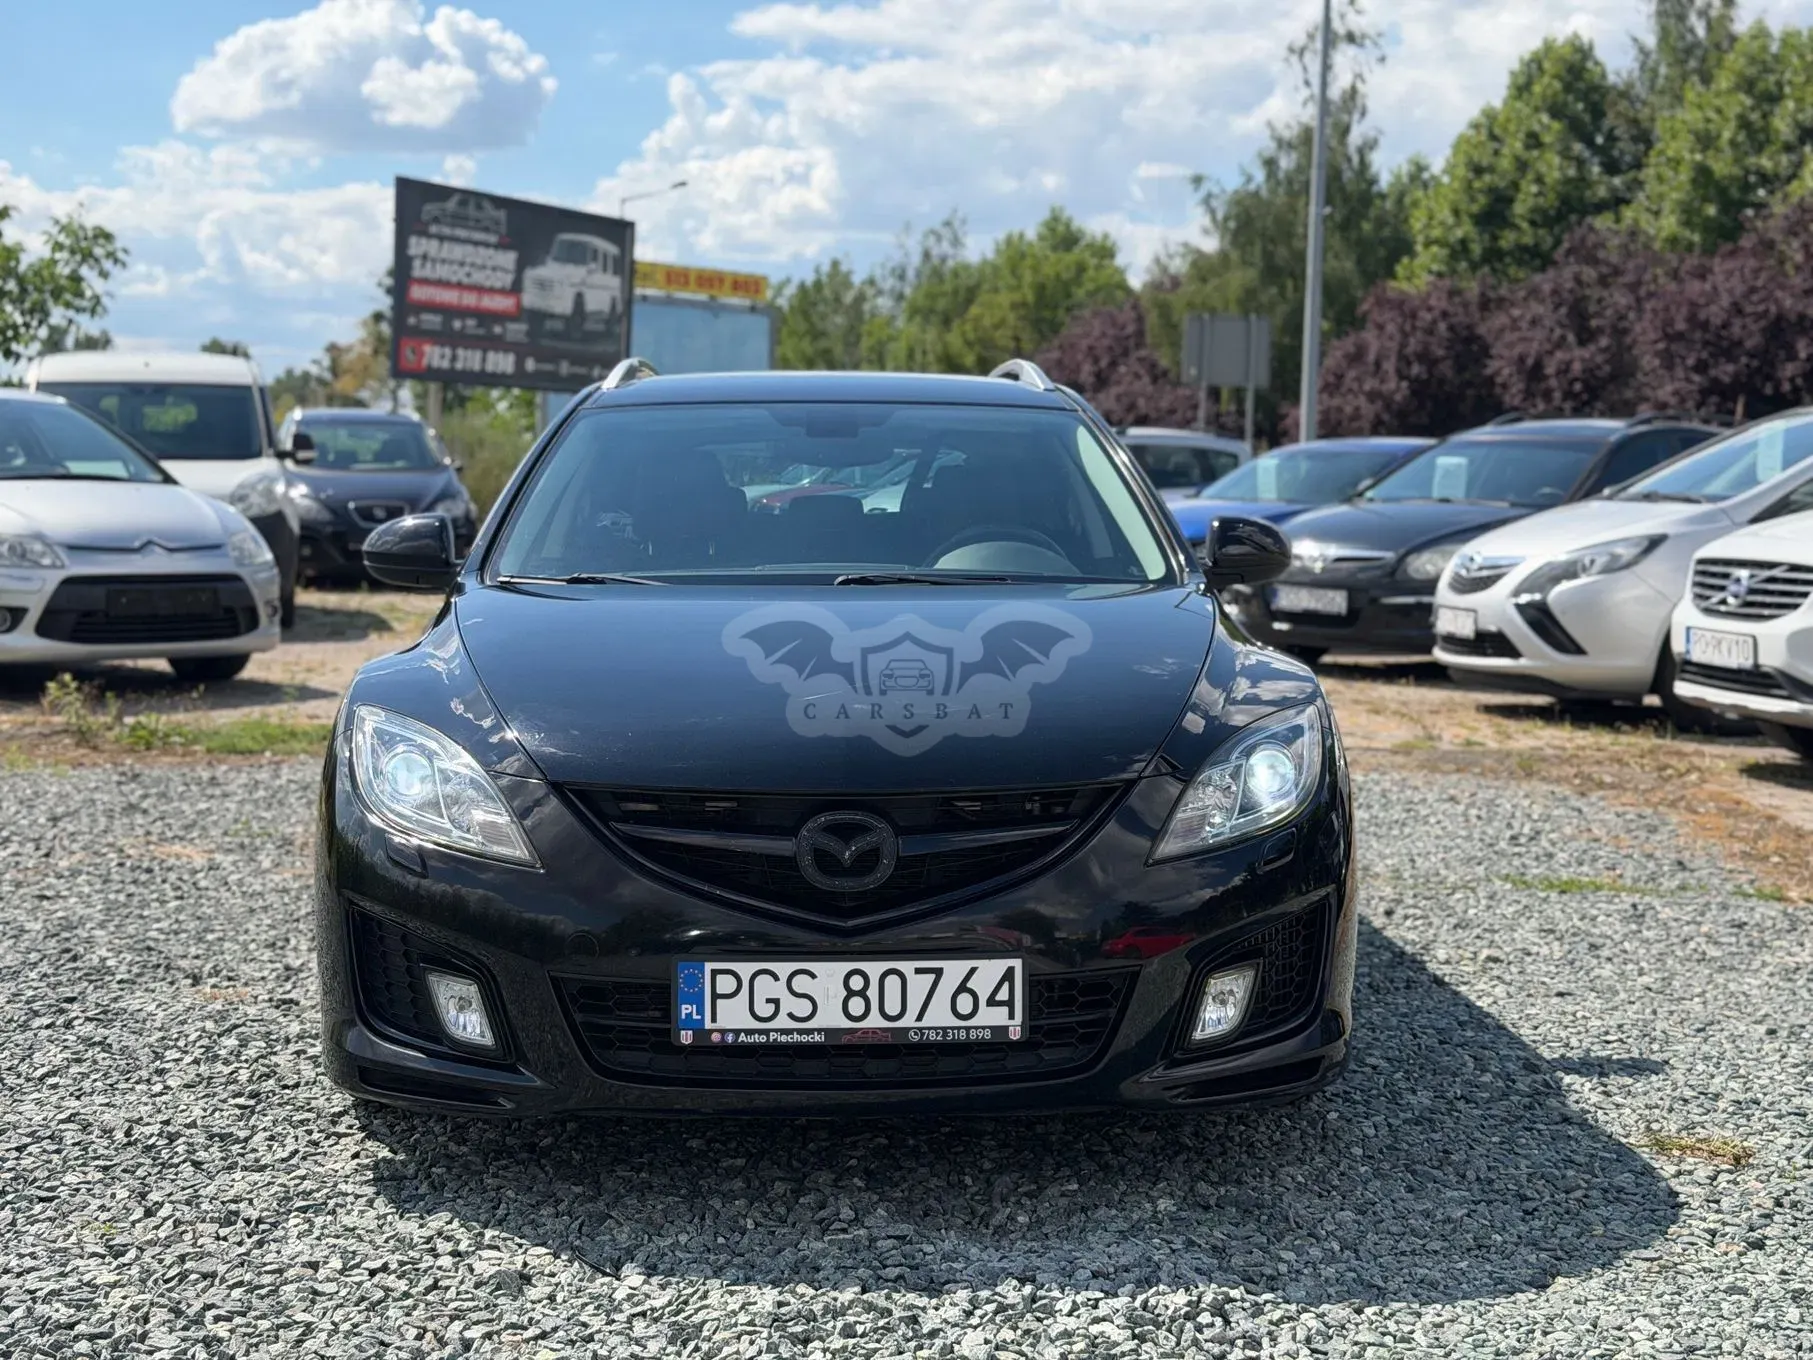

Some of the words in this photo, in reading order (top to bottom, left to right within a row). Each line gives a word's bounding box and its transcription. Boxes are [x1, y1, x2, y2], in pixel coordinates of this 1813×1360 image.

[709, 967, 819, 1024] PGS
[841, 965, 1016, 1023] 80764
[681, 1004, 701, 1019] PL
[738, 1032, 767, 1043] Auto
[769, 1031, 825, 1043] Piechocki
[922, 1029, 943, 1040] 782
[946, 1029, 967, 1040] 318
[969, 1028, 991, 1040] 898
